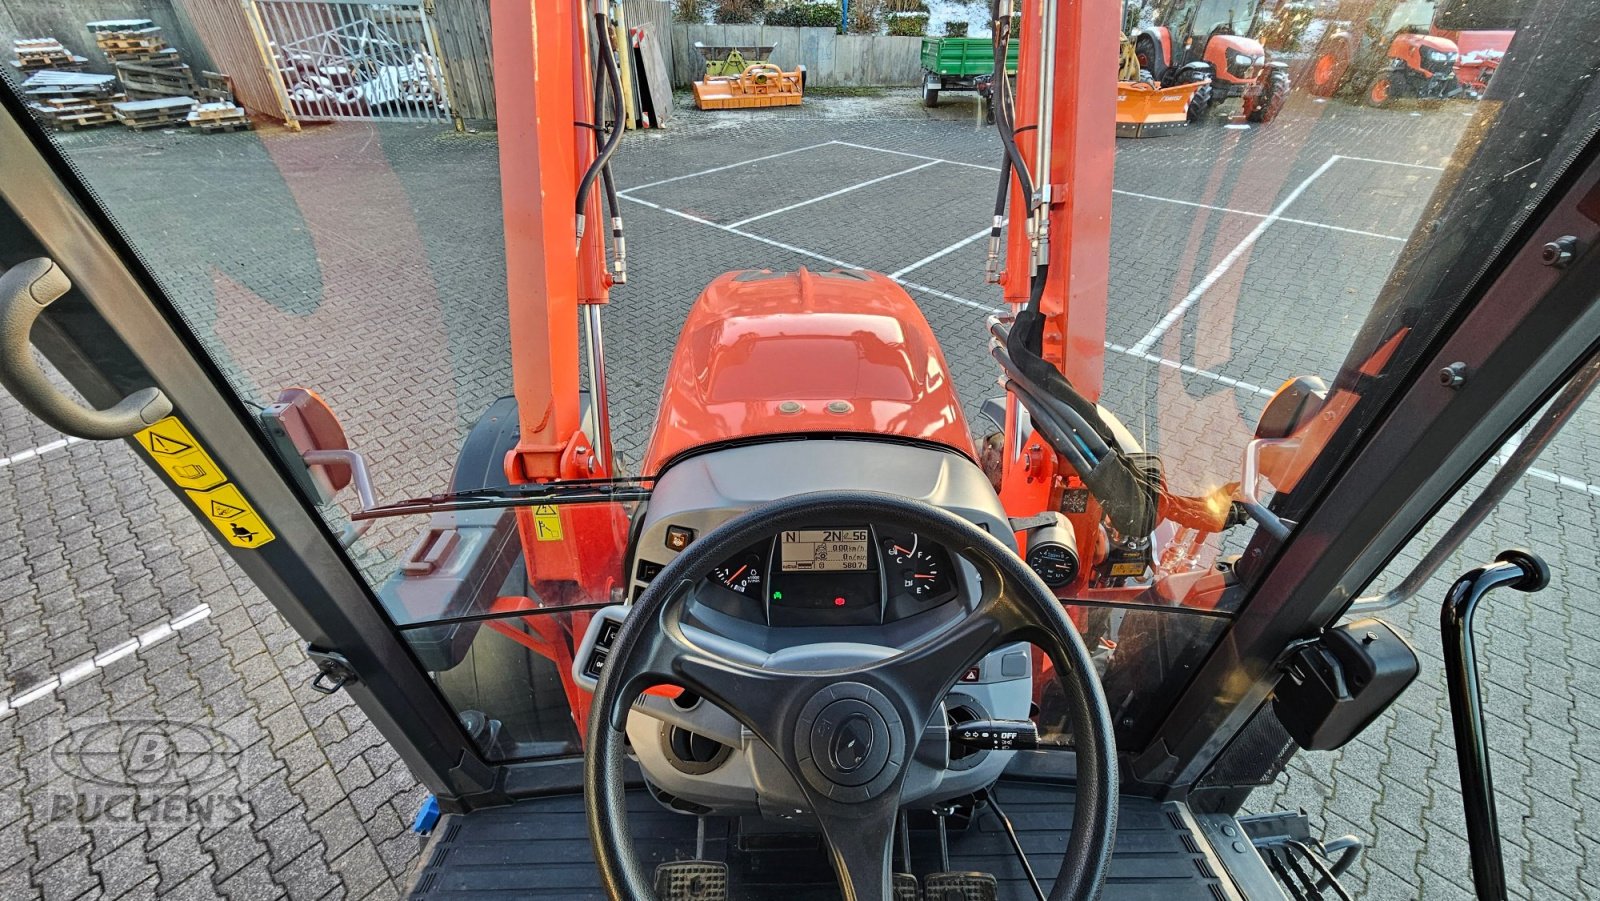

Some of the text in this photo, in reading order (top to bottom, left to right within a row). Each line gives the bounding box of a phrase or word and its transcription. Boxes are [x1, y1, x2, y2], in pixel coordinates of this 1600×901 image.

[786, 531, 867, 542] N 2N 56
[917, 551, 923, 559] F
[896, 556, 903, 564] C
[741, 579, 747, 587] 0
